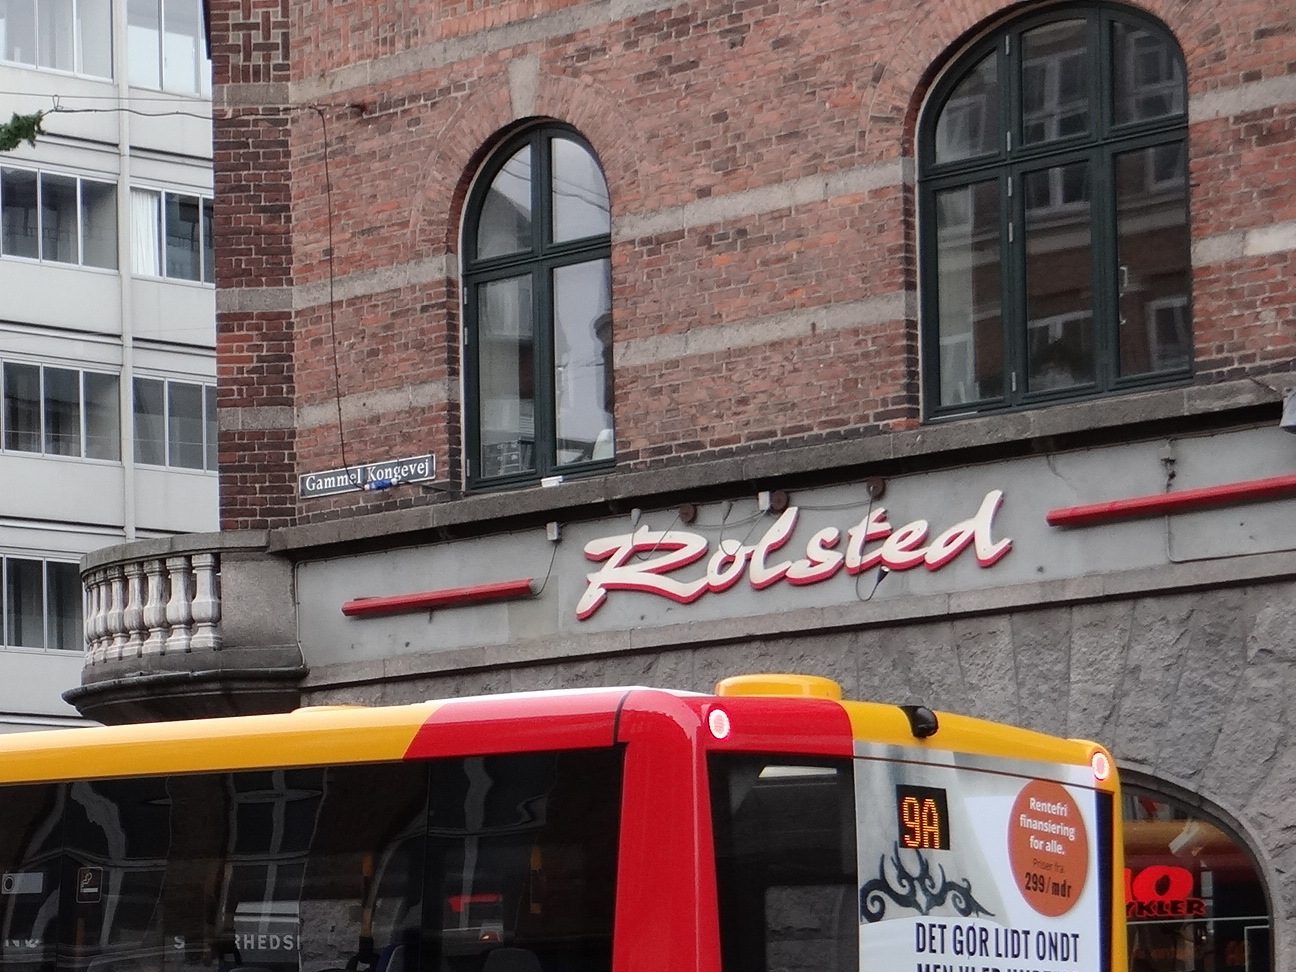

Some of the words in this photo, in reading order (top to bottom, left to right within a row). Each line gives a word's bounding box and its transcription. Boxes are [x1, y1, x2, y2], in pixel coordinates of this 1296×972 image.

[305, 468, 361, 491] Gammel
[366, 459, 429, 482] Kongevej
[1029, 797, 1069, 817] Rentefri
[902, 795, 940, 850] 9A
[1019, 814, 1076, 841] finansiering
[1029, 835, 1043, 850] for
[1045, 839, 1066, 856] alle.
[915, 922, 947, 954] DET
[952, 922, 990, 960] GØR
[994, 927, 1031, 960] LIDT
[1036, 930, 1080, 963] ONDT
